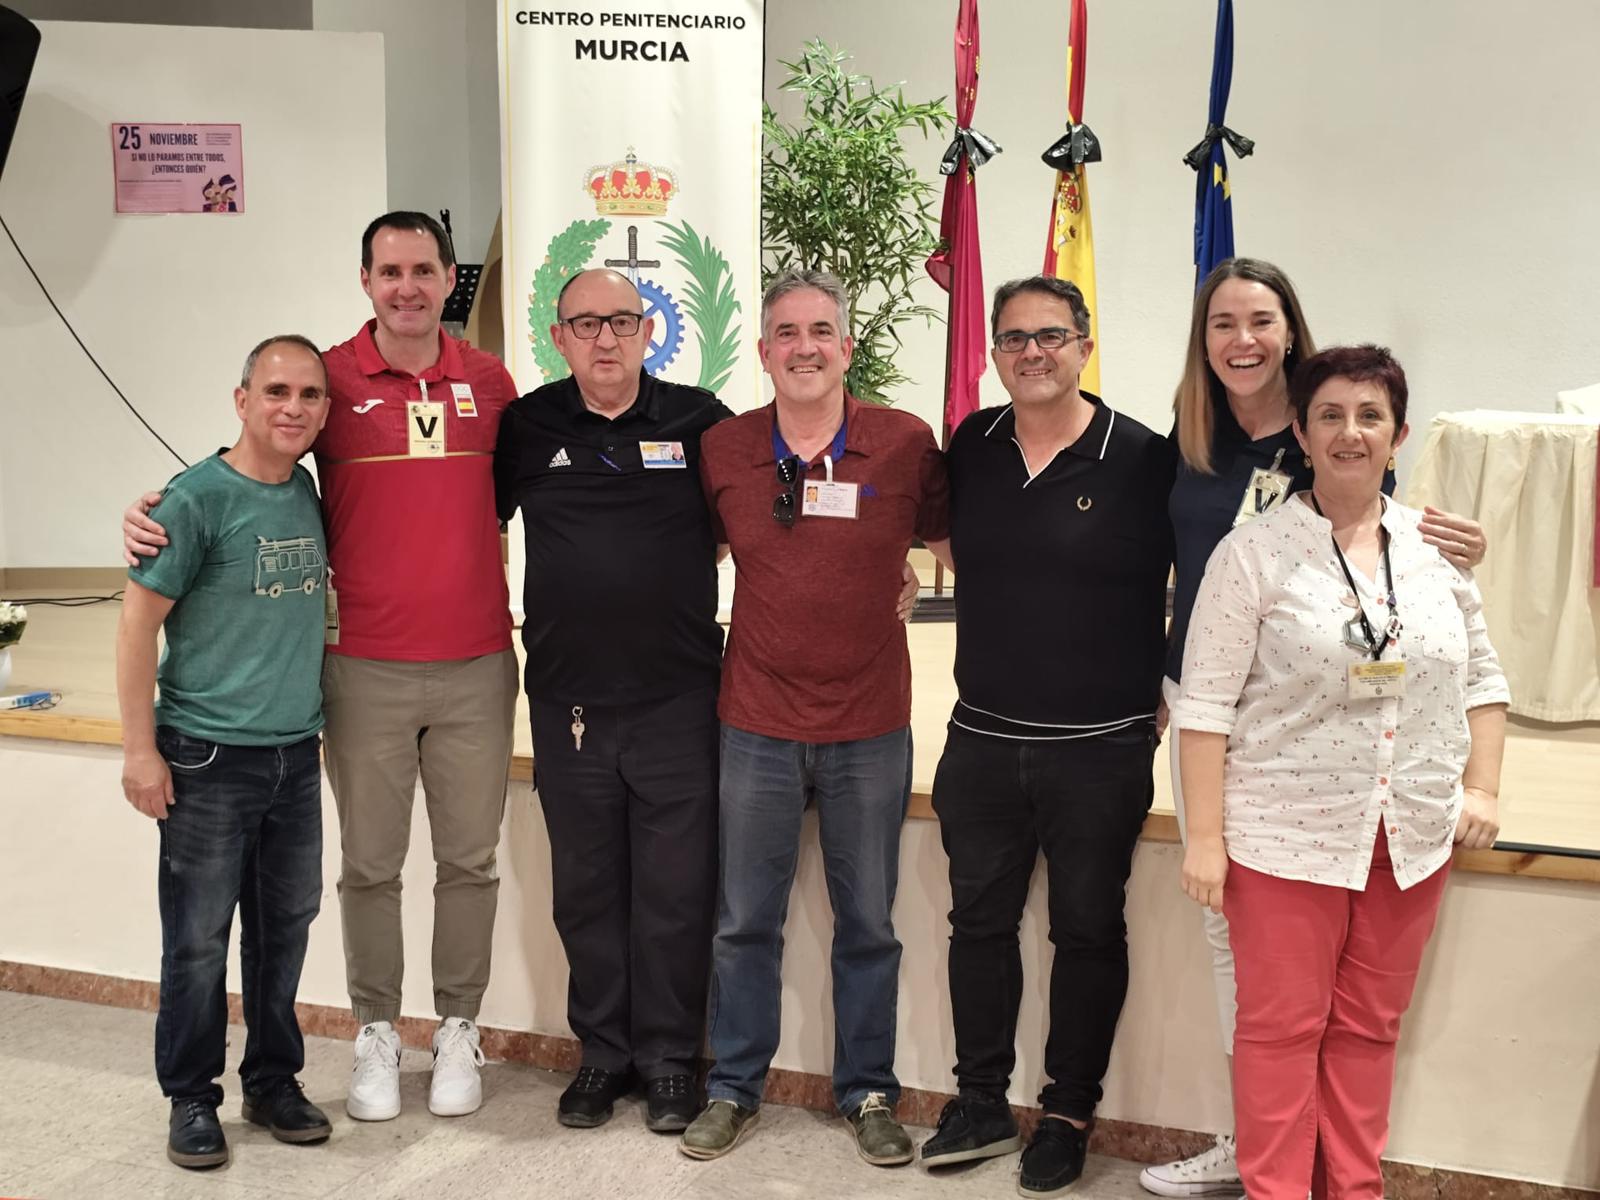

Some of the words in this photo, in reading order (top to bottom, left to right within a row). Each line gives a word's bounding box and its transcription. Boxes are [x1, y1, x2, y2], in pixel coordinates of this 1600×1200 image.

[515, 11, 594, 26] CENTRO
[600, 12, 746, 29] PENITENCIARIO
[575, 39, 690, 62] MURCIA
[119, 126, 141, 150] 25
[149, 133, 198, 145] NOVIEMBRE
[131, 153, 138, 162] SI
[138, 153, 147, 162] NO
[148, 153, 156, 162] LO
[156, 153, 185, 162] PARAMOS
[186, 153, 204, 162] ENTRE
[205, 153, 226, 163] TODOS,
[151, 165, 185, 175] ¿ENTONCES
[185, 164, 206, 174] QUIÉN?
[415, 416, 438, 438] V
[549, 459, 572, 468] adidas
